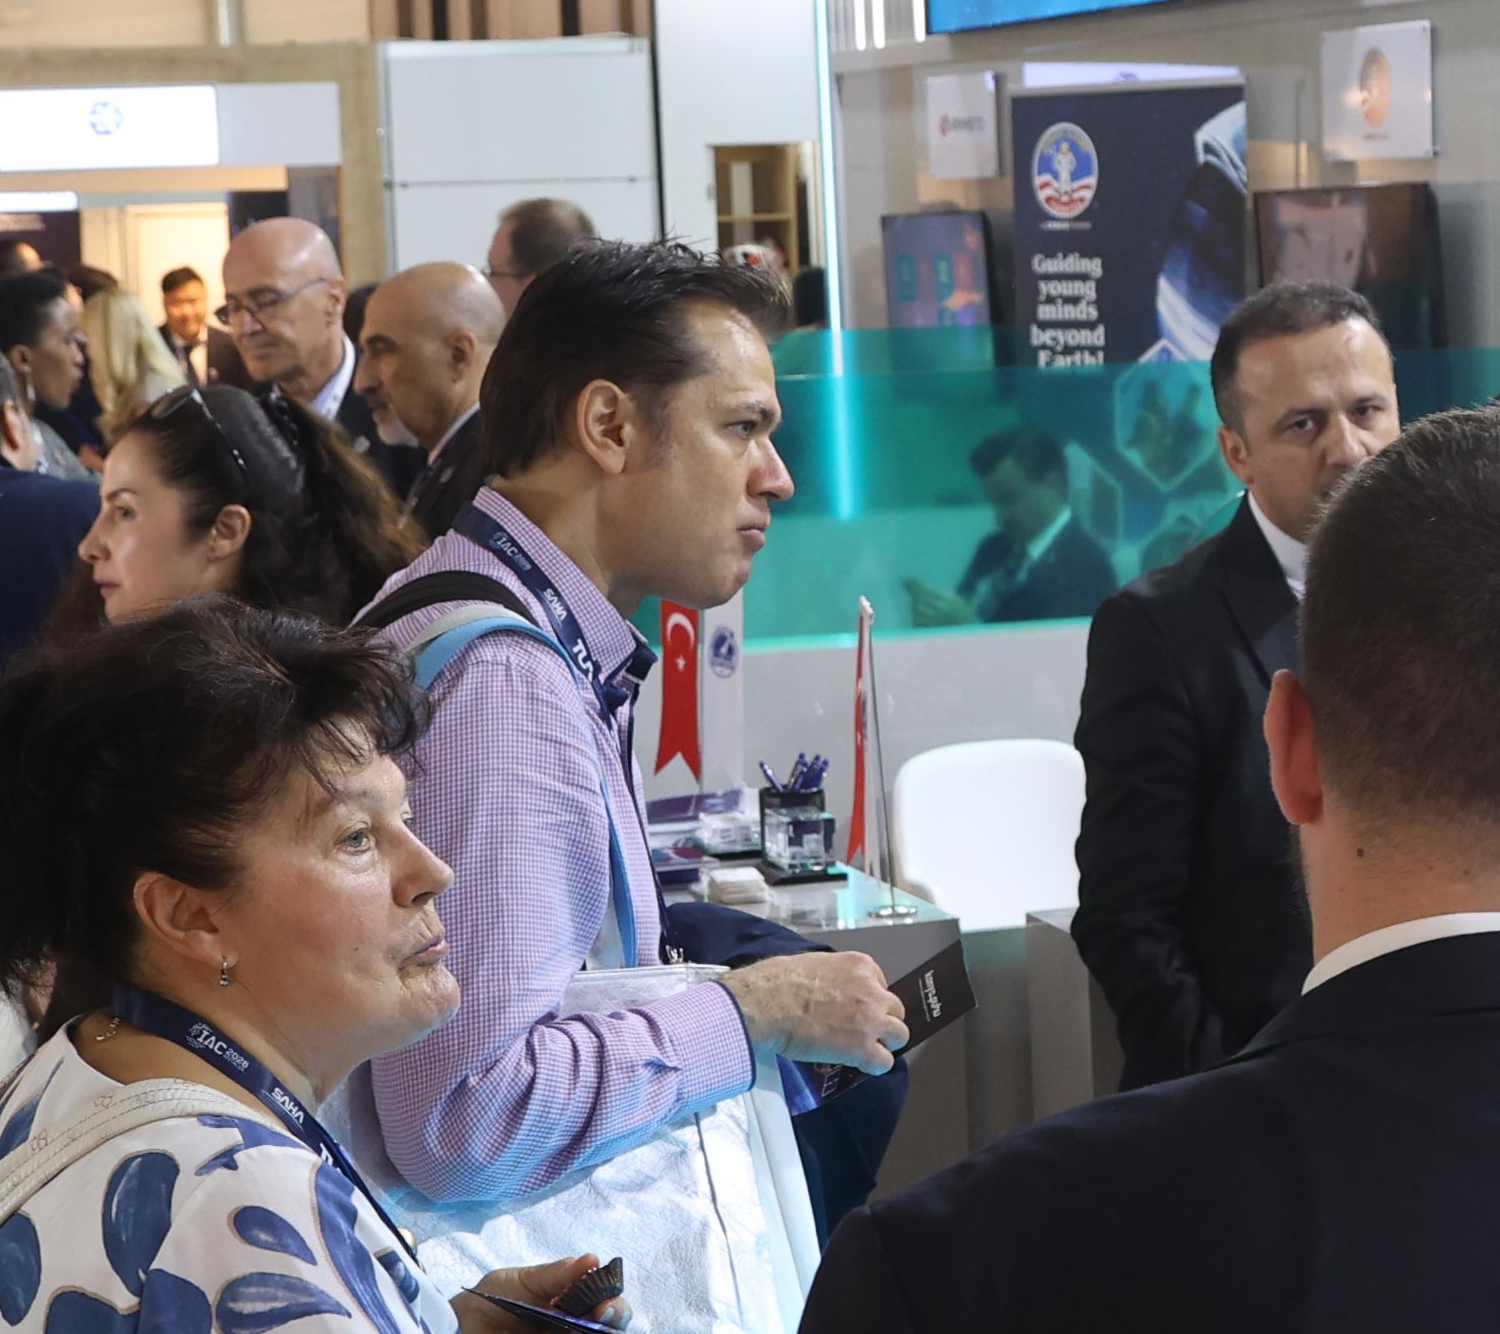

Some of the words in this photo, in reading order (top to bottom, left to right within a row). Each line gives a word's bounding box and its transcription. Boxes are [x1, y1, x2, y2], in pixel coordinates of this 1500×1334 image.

[1031, 252, 1103, 277] Guiding
[1037, 278, 1097, 301] young
[1037, 299, 1098, 321] minds
[1030, 323, 1105, 351] beyond
[1037, 347, 1104, 369] Earth!
[197, 1029, 227, 1055] IAC
[271, 1087, 305, 1124] SAHA
